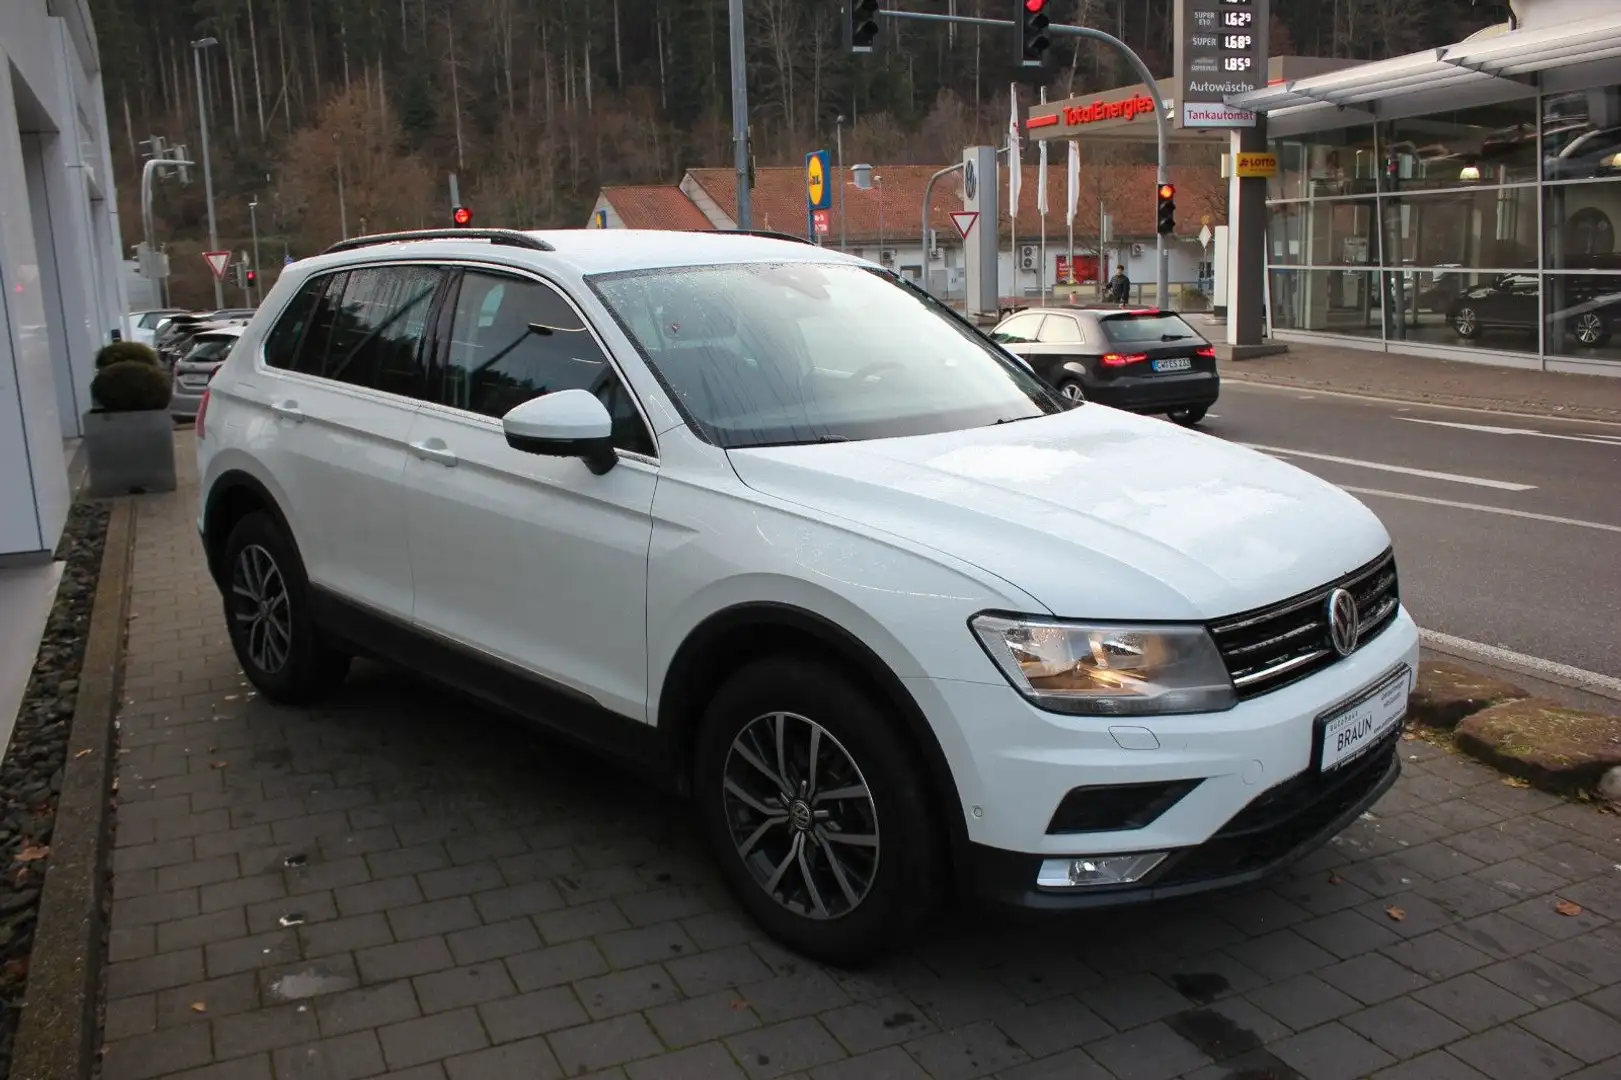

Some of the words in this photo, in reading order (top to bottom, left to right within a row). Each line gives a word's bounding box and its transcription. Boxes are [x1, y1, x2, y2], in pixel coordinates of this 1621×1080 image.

[1192, 37, 1216, 46] SUPER
[1189, 81, 1254, 93] Autowäsche
[1063, 93, 1154, 126] TotalEnergies
[1187, 109, 1254, 121] Tankautomat
[1250, 157, 1276, 167] LOTTO
[1337, 715, 1372, 752] BRAUN
